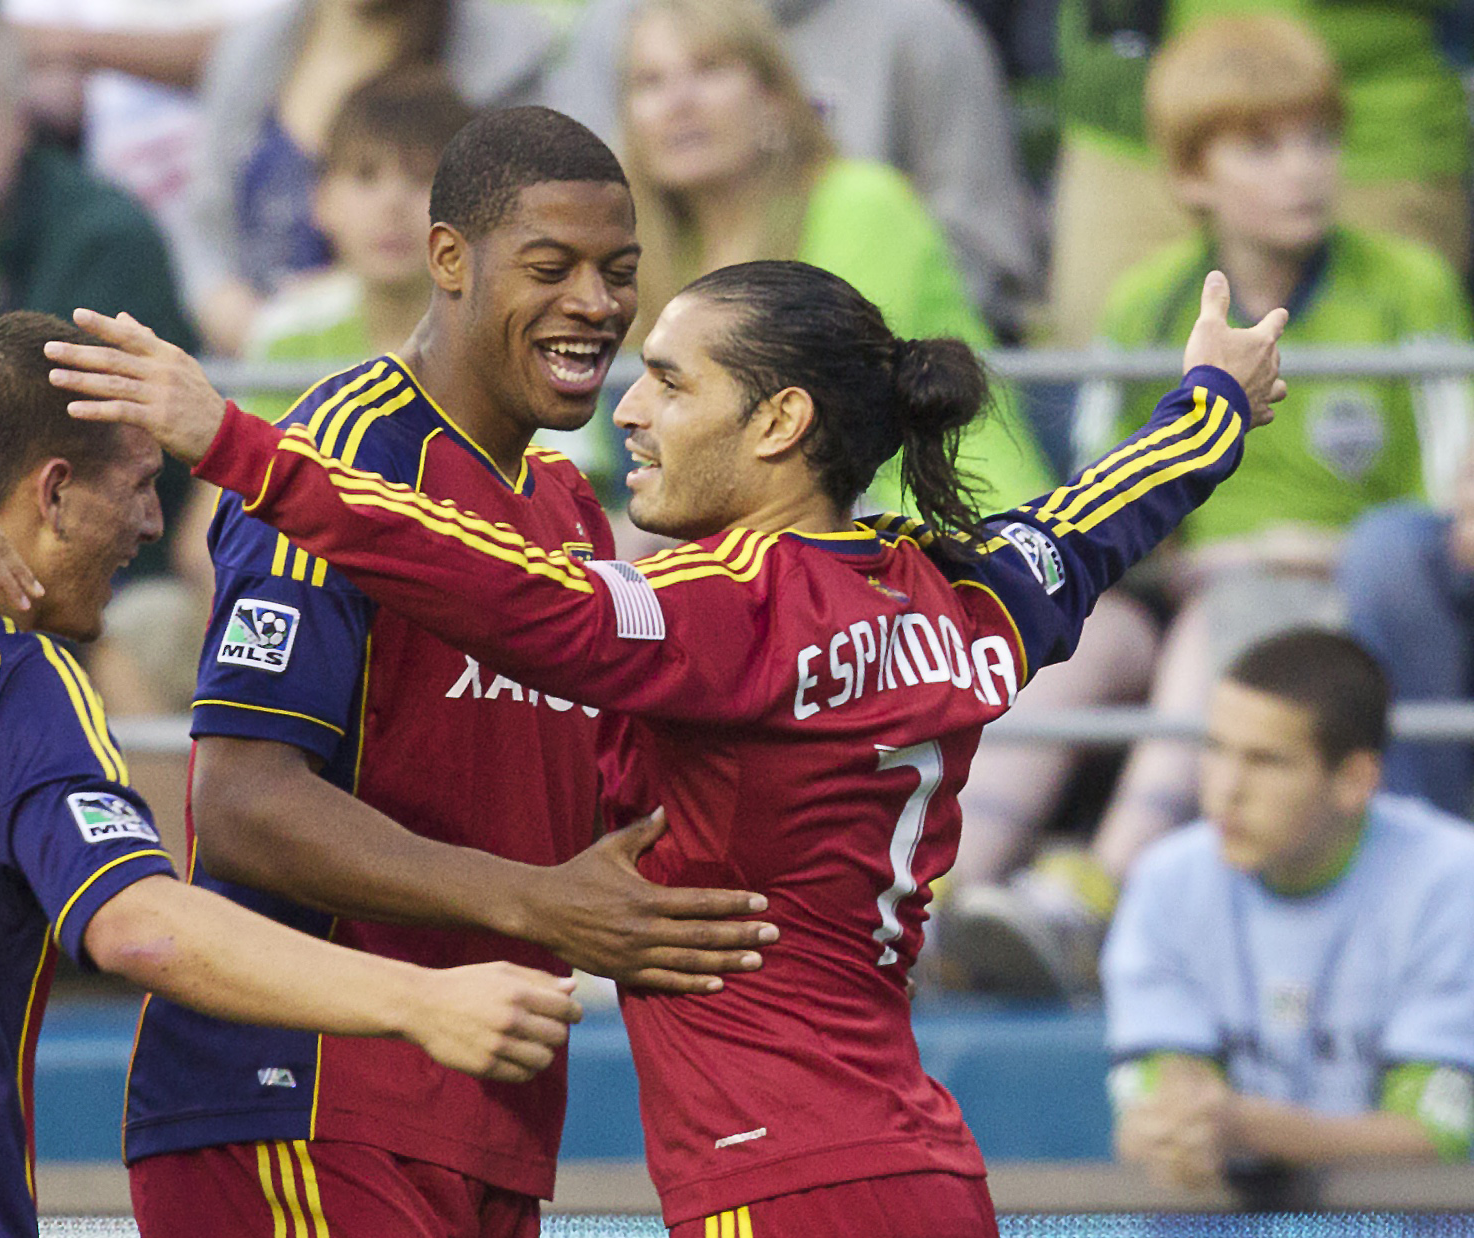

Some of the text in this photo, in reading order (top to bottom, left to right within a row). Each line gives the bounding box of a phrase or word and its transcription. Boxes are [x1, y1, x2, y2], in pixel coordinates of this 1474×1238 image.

[222, 645, 284, 666] MLS
[793, 612, 1019, 721] ESPINDOA
[874, 738, 944, 967] 7
